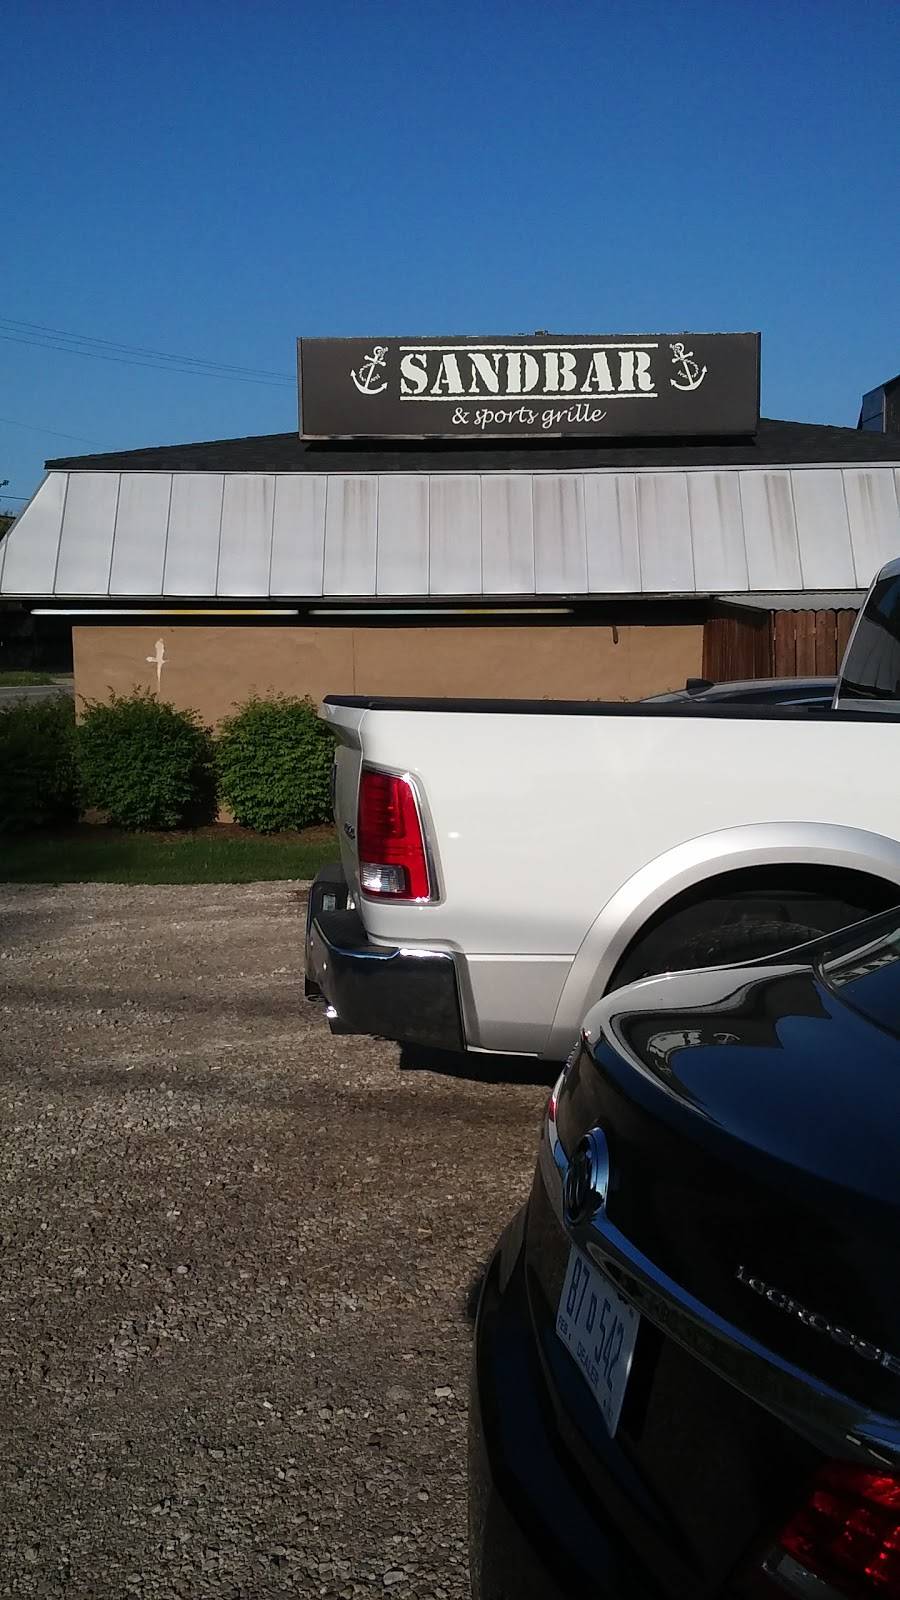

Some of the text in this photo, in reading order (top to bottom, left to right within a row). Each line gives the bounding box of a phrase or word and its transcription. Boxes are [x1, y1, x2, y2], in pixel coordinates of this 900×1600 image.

[400, 352, 655, 394] SANDBAR
[451, 404, 607, 429] & sports grille
